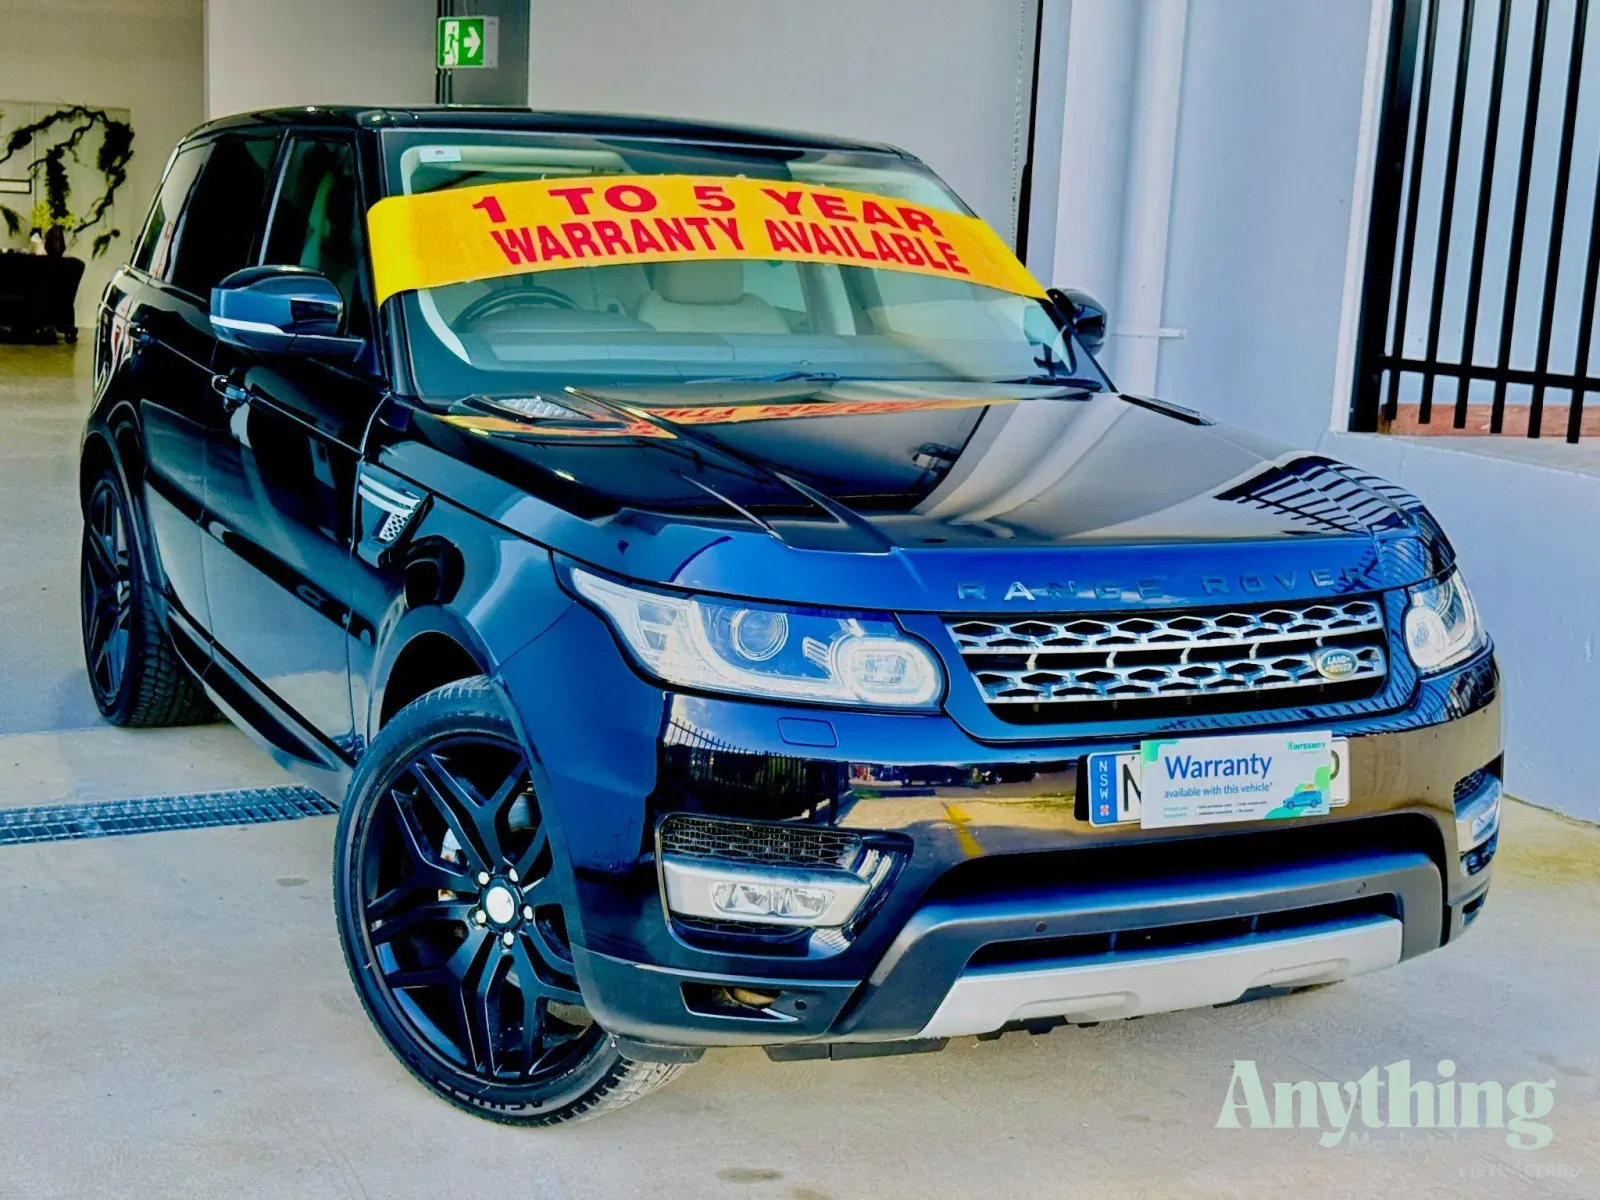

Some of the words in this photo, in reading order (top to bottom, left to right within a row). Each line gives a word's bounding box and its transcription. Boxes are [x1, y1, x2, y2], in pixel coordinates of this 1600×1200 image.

[473, 196, 506, 223] 1
[548, 185, 657, 216] TO
[694, 186, 735, 212] 5
[763, 189, 943, 237] YEAR
[491, 217, 745, 265] WARRANTY
[770, 220, 970, 275] AVAILABLE
[957, 579, 1165, 602] RANGE
[1200, 566, 1370, 594] ROVER
[1326, 655, 1347, 665] LAND
[1329, 662, 1353, 673] ROVER
[1098, 760, 1109, 800] NSW
[1163, 752, 1273, 780] Warranty
[1163, 784, 1200, 799] available
[1202, 784, 1222, 796] with
[1223, 782, 1240, 794] this
